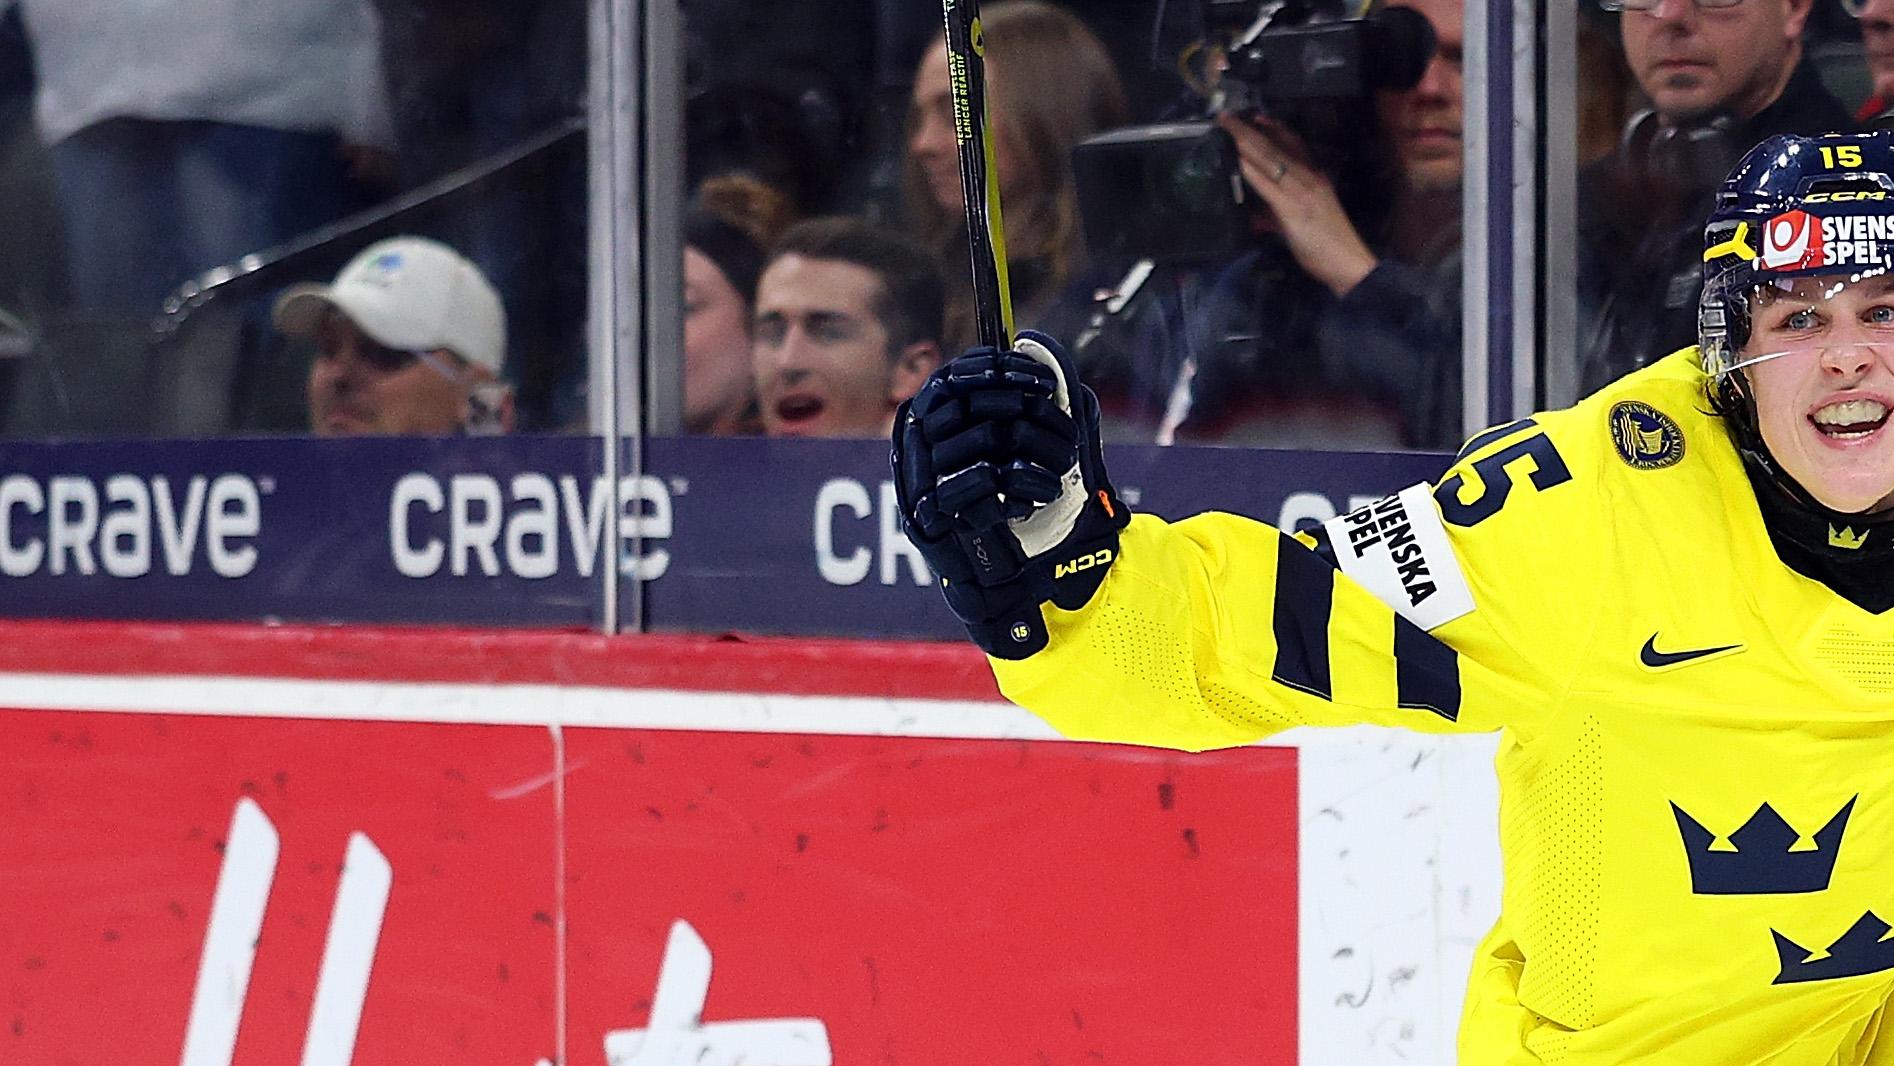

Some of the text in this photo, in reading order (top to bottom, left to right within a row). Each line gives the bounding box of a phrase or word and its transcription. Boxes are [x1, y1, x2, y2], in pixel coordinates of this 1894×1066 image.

[1819, 145, 1863, 169] 15
[1803, 191, 1886, 203] CCM
[1823, 240, 1882, 265] SPEL
[1343, 506, 1382, 558] PEL
[1055, 548, 1113, 579] CCM
[1373, 496, 1437, 608] VENSKA
[1013, 626, 1028, 638] 15
